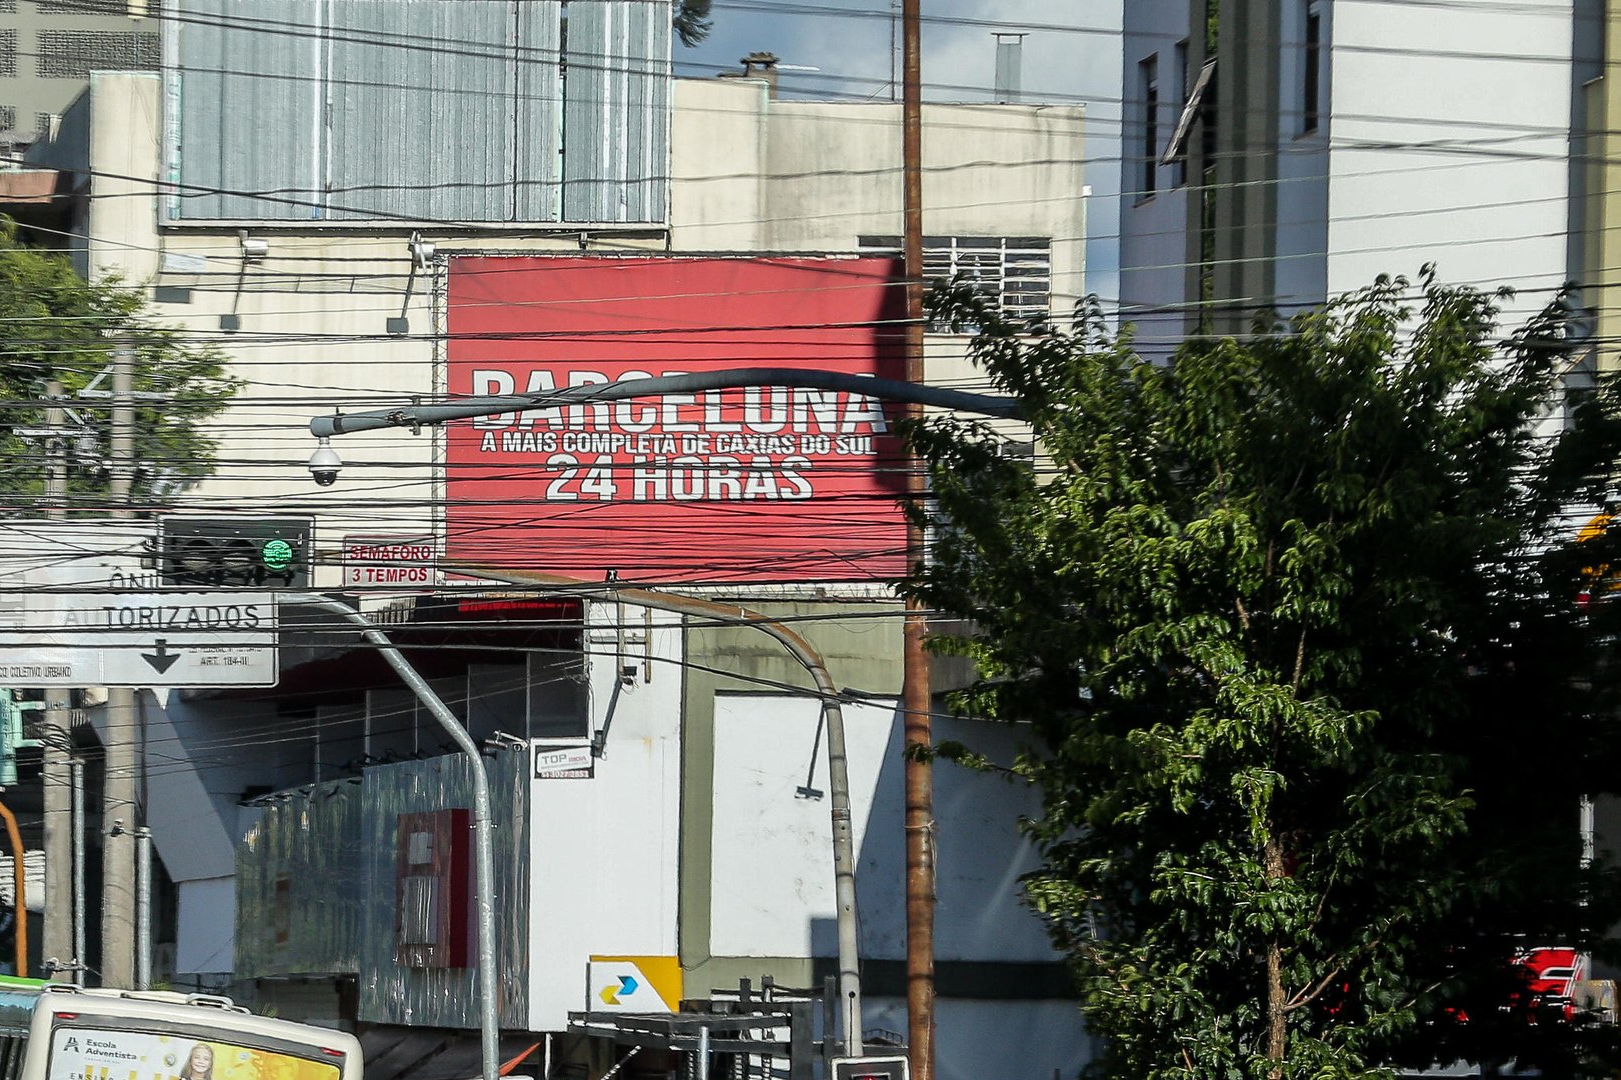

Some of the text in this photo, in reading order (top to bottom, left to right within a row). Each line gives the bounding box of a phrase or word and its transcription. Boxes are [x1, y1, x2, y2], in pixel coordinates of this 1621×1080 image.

[481, 431, 879, 455] A MAIS COMPLETA DE CAXIAS DO SUL
[546, 453, 813, 501] 24 HORAS
[352, 566, 428, 583] 3 TEMPOS
[65, 605, 260, 629] AUTORIZADOS
[541, 753, 567, 765] TOP
[86, 1038, 117, 1049] Escola
[85, 1047, 138, 1060] Adventista
